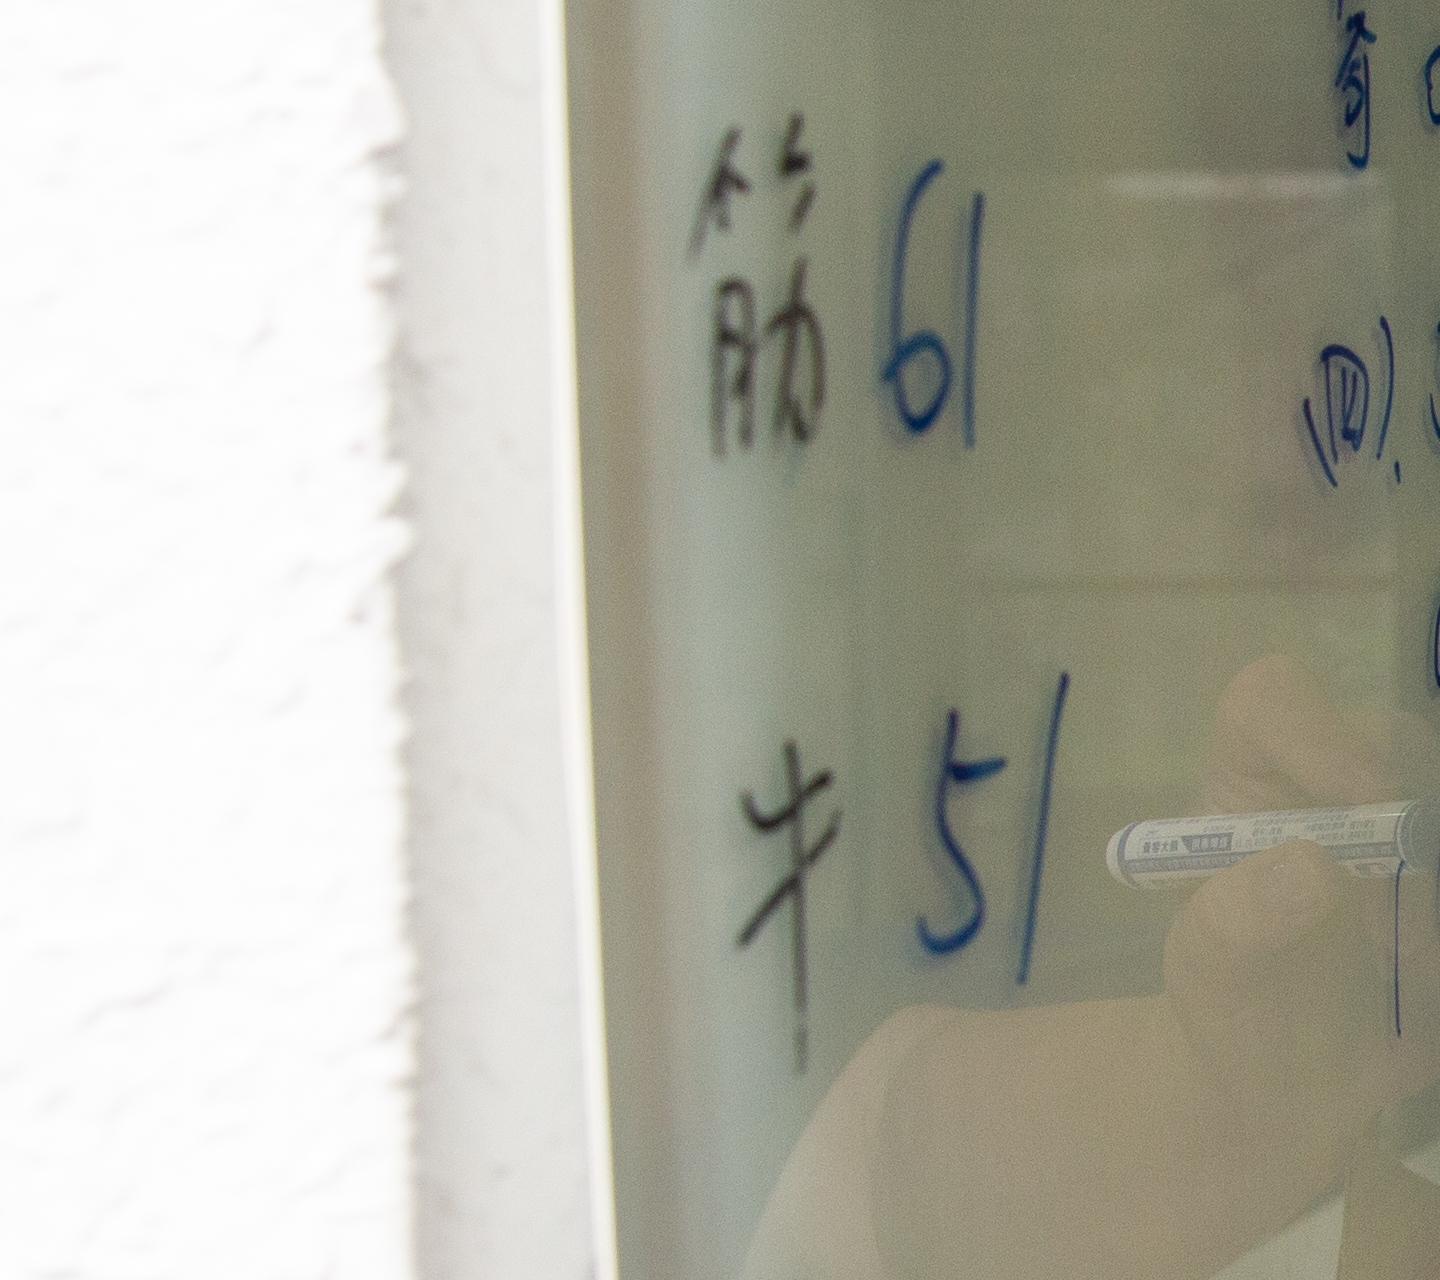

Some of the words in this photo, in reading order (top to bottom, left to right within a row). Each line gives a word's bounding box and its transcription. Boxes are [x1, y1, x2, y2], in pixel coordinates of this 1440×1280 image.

[880, 158, 985, 449] 61
[735, 737, 845, 1076] 牛
[917, 671, 1070, 986] 51
